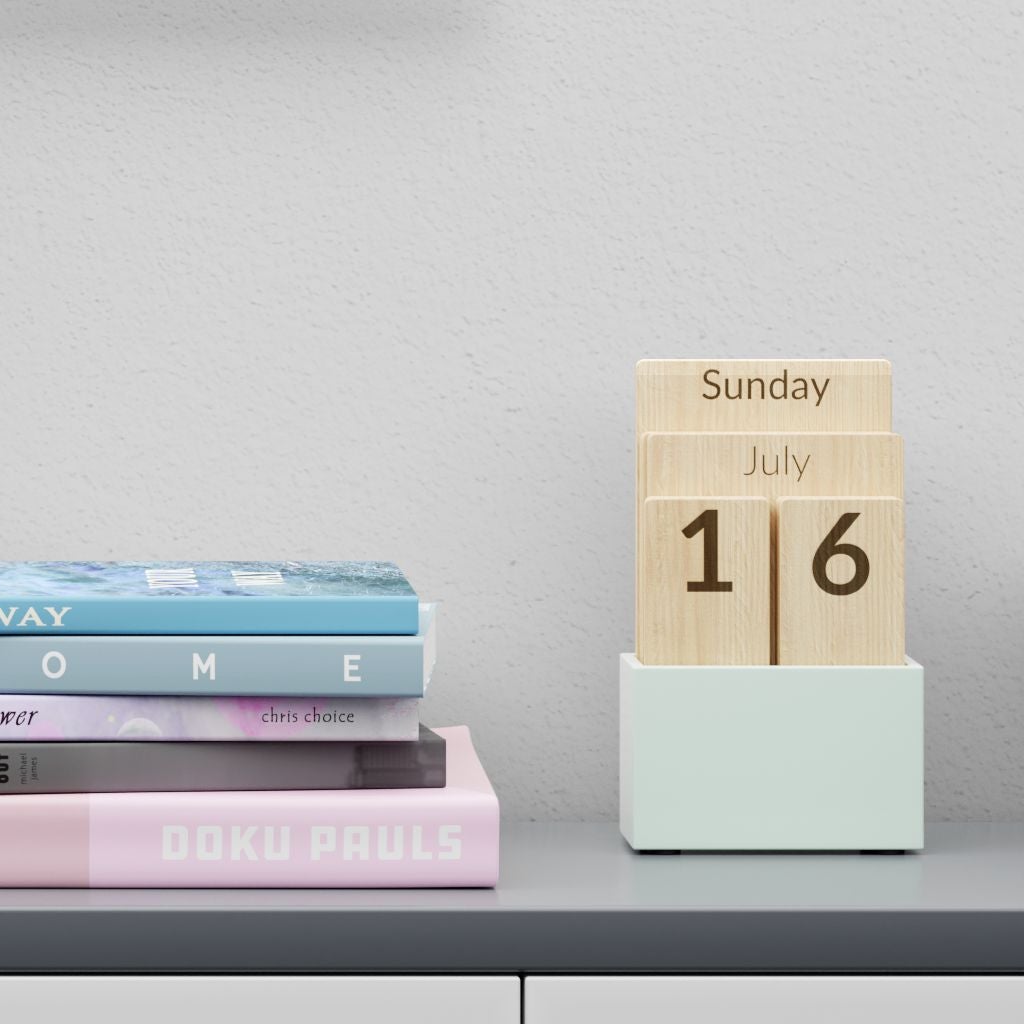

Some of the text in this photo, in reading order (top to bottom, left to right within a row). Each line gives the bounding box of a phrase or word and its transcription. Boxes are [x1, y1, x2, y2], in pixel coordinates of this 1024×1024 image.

[701, 369, 830, 406] Sunday
[743, 445, 811, 482] July
[261, 706, 355, 724] chris choice
[162, 825, 462, 860] DOKU PAULS
